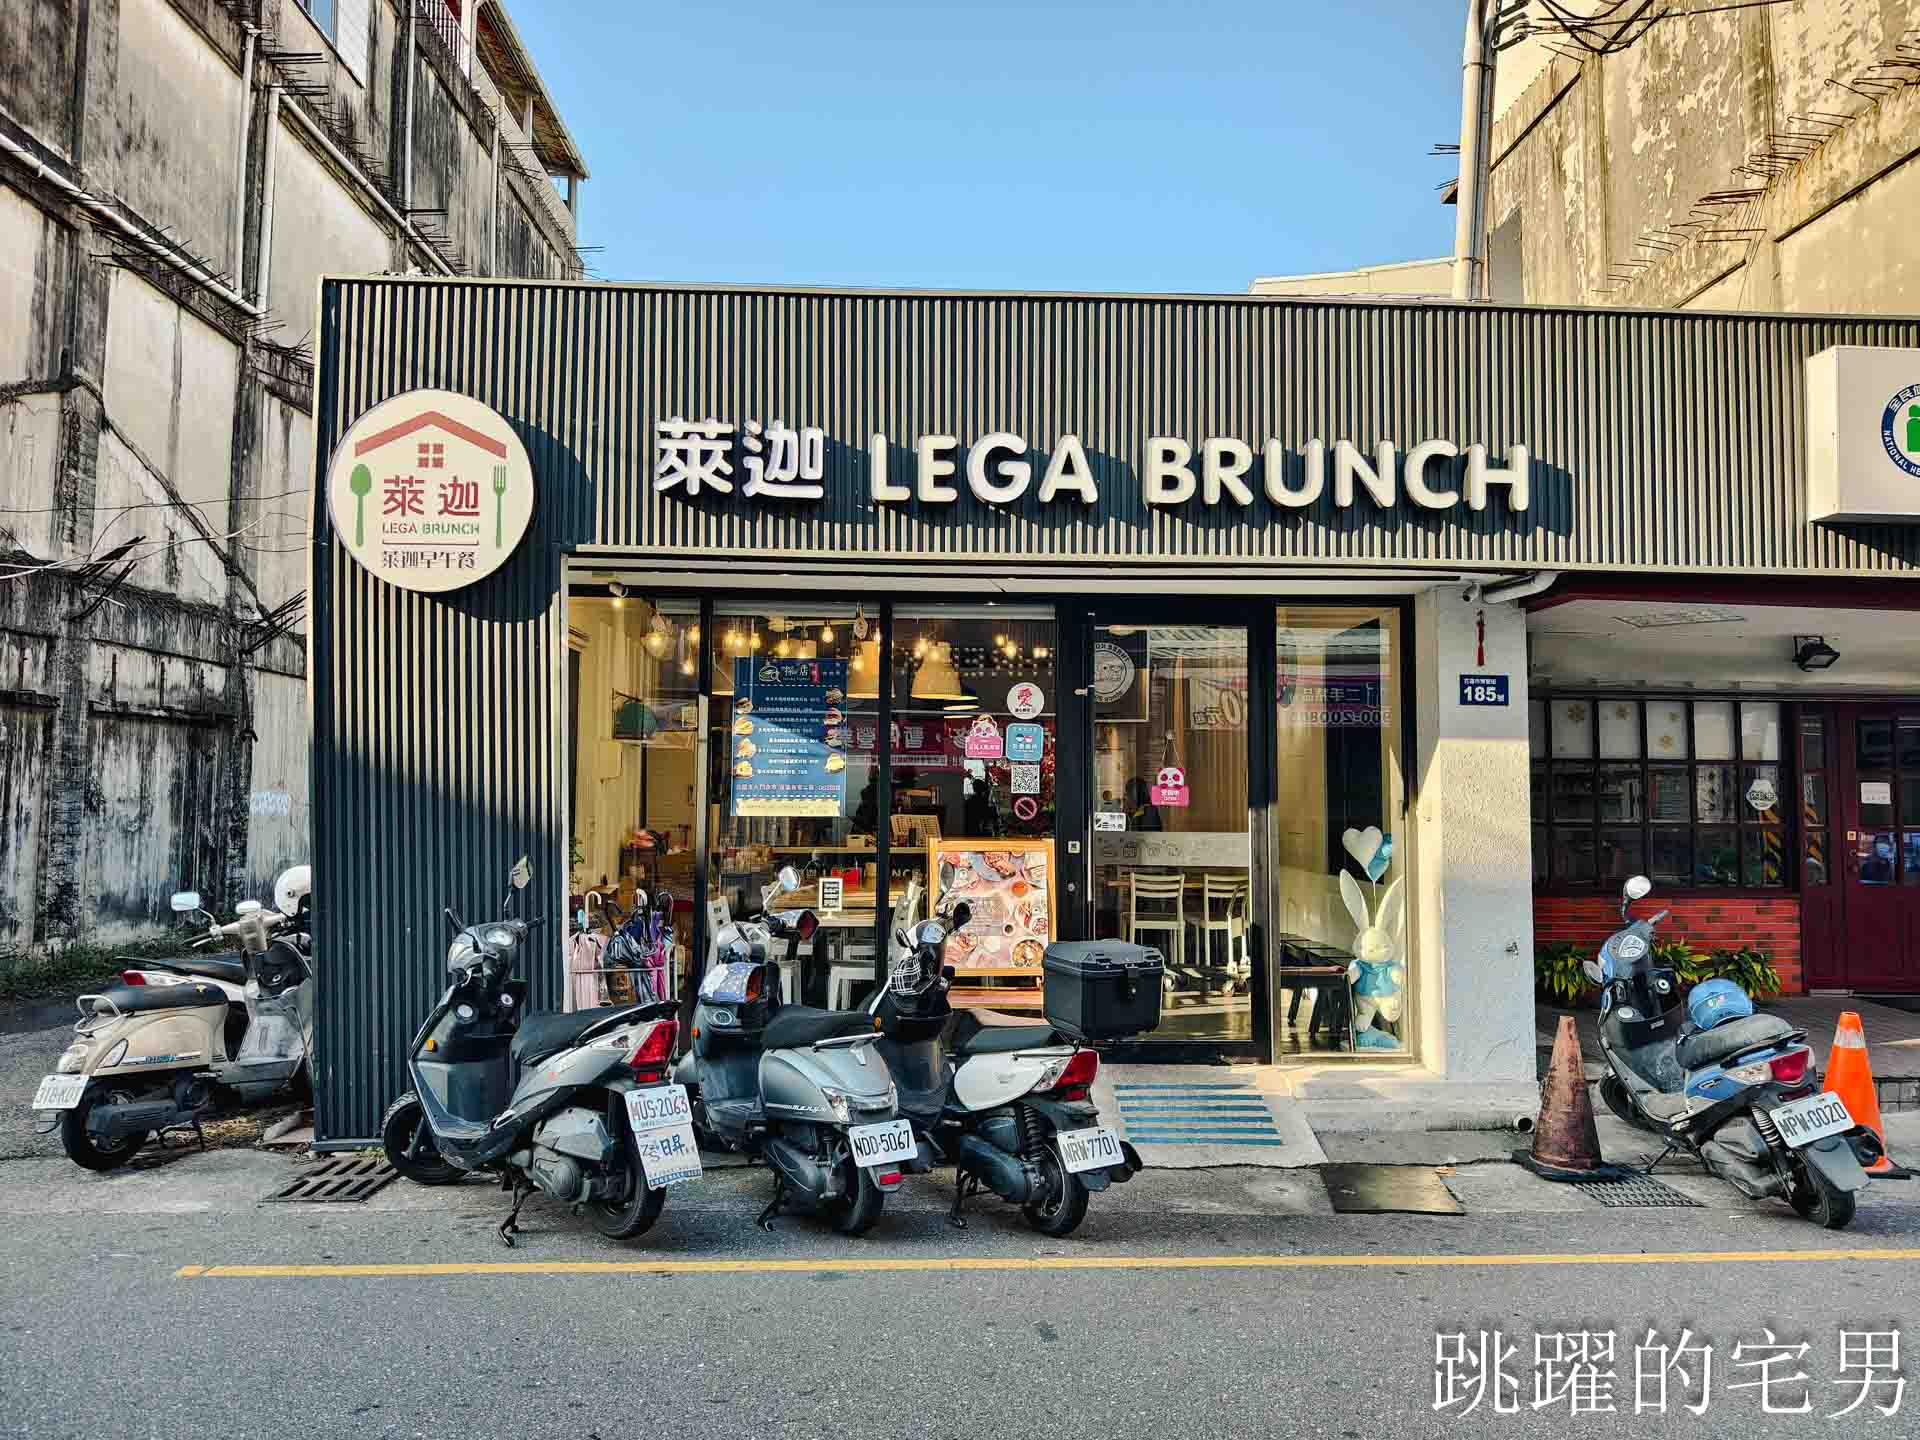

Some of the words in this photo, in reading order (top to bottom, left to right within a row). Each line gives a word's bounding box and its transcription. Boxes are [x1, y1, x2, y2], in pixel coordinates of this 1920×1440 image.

[653, 416, 824, 499] 萊迦
[870, 431, 1099, 504] LEGA
[1143, 437, 1530, 512] BRUNCH
[1883, 430, 1908, 470] NATIONAL
[382, 475, 481, 517] 萊迦
[382, 523, 418, 535] LEGA
[421, 523, 480, 535] BRUNCH
[630, 1095, 689, 1121] MUS-2063
[1777, 1102, 1847, 1138] MPW-0020
